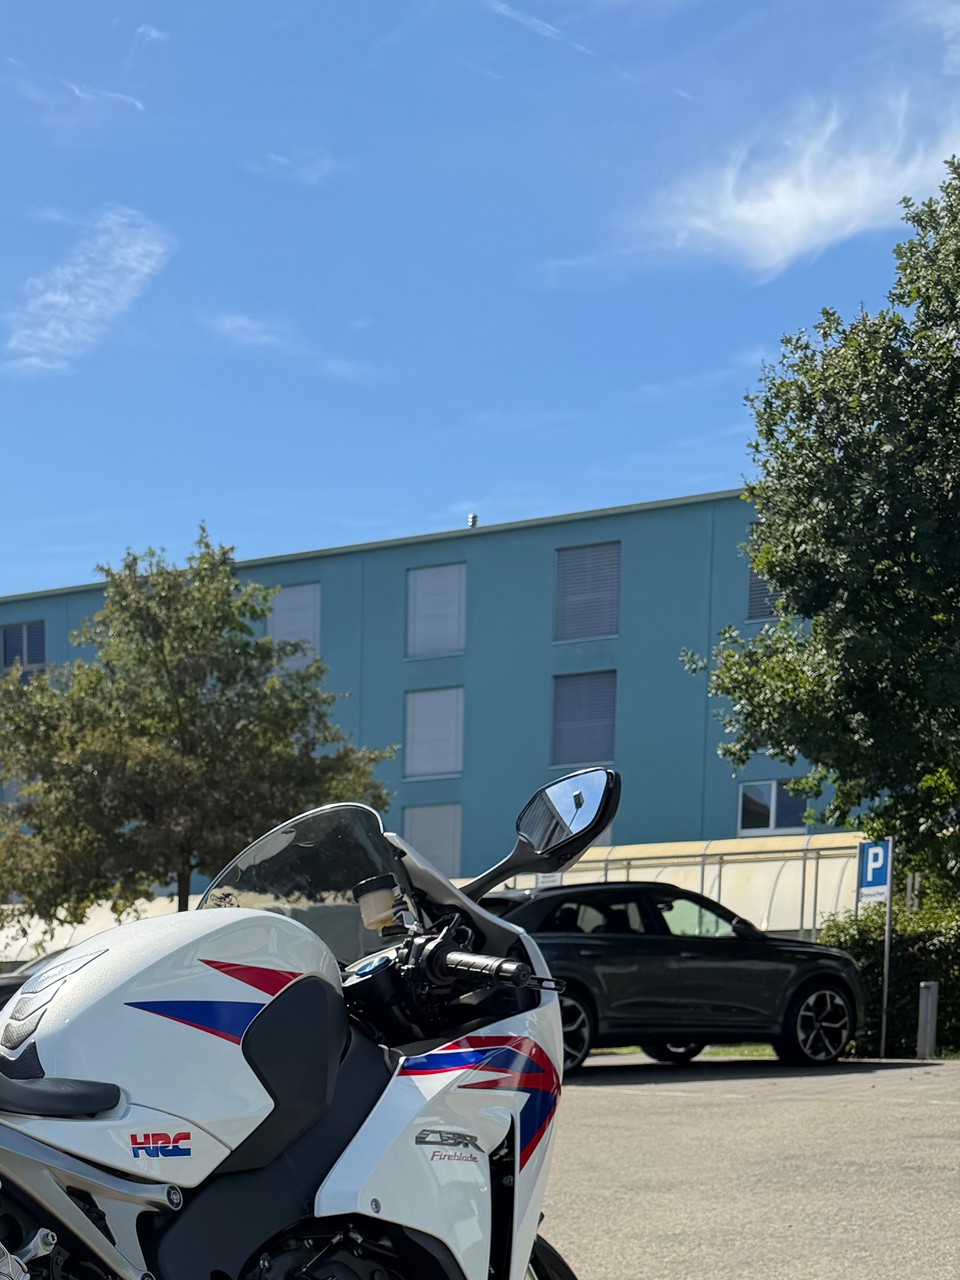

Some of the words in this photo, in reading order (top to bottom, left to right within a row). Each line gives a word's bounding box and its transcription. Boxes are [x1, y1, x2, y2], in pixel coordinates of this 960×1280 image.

[867, 846, 884, 881] P
[130, 1132, 191, 1158] HRC
[415, 1129, 485, 1153] CBR
[430, 1151, 479, 1162] Fireblade
